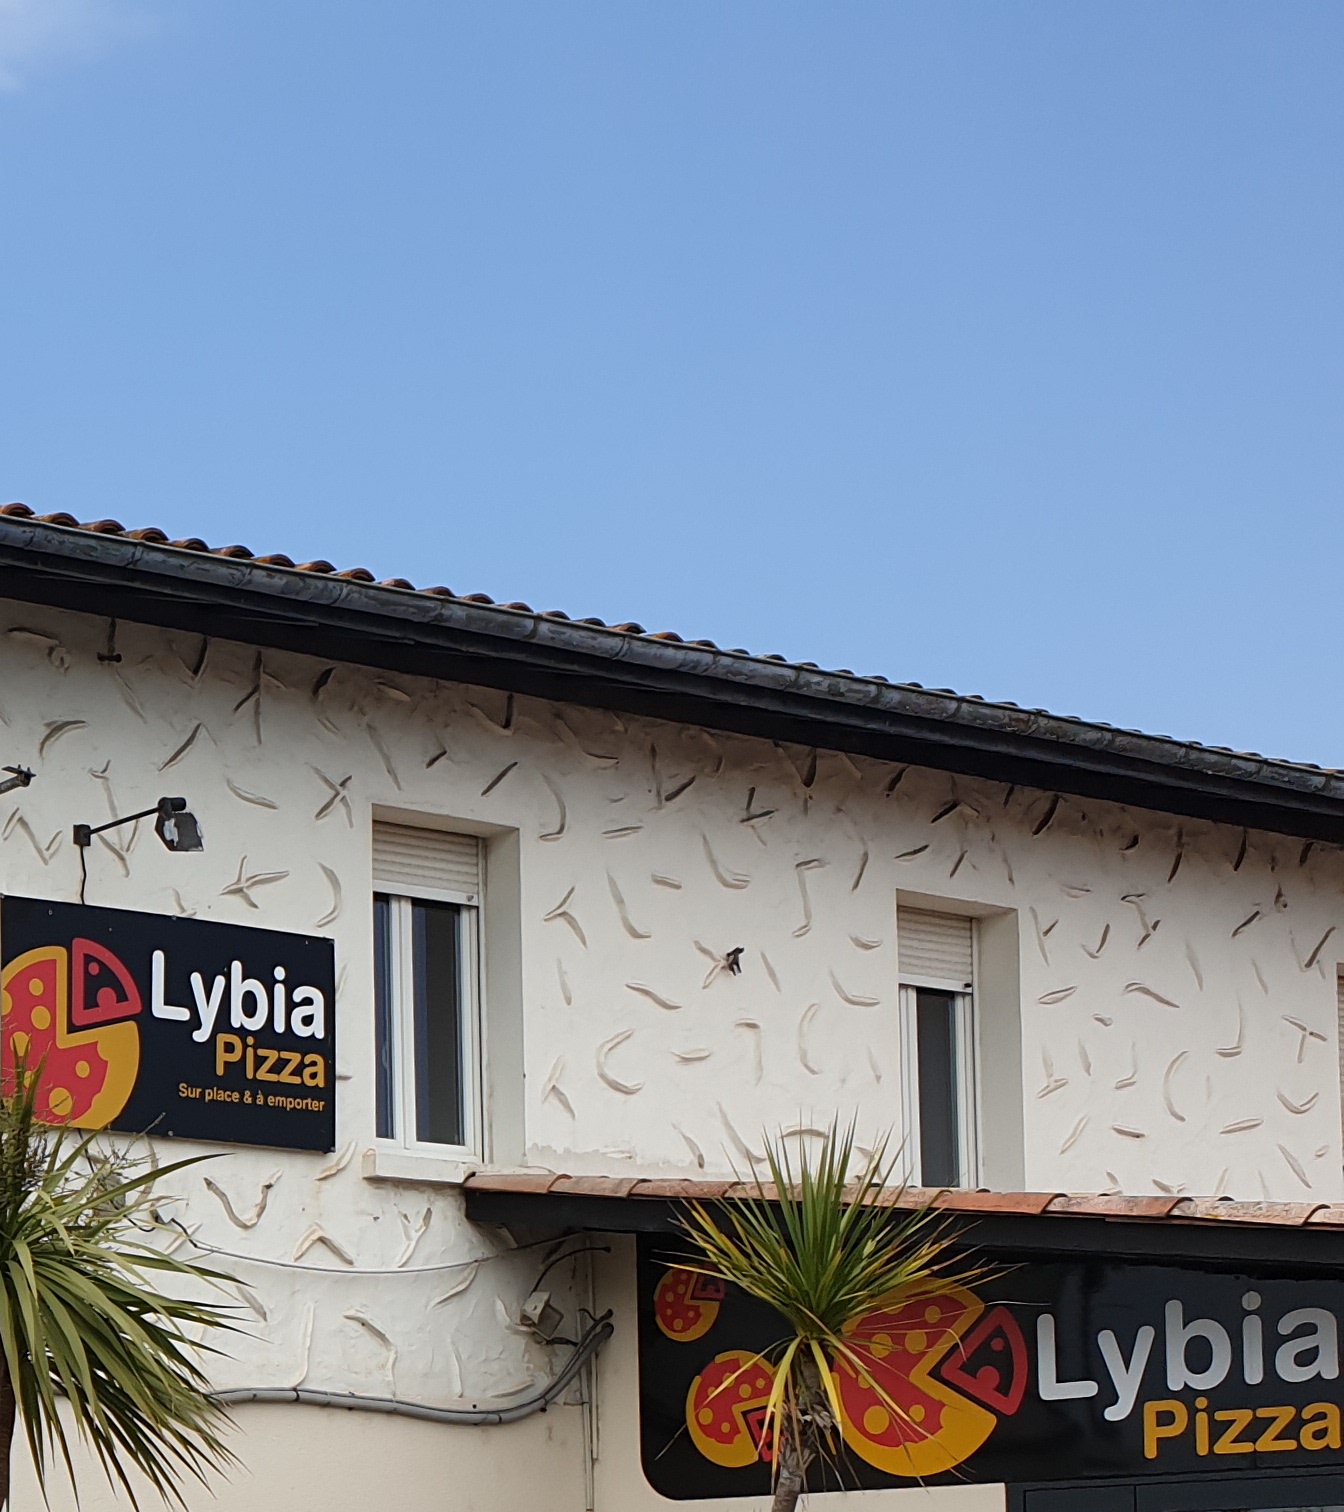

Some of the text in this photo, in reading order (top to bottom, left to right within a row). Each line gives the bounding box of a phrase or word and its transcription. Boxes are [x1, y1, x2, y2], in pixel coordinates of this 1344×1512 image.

[151, 949, 325, 1042] Lybia
[215, 1032, 325, 1088] Pizza
[178, 1083, 325, 1112] Sur place & à emporter
[1036, 1290, 1340, 1422] Lybia
[1143, 1396, 1342, 1460] Pizza
